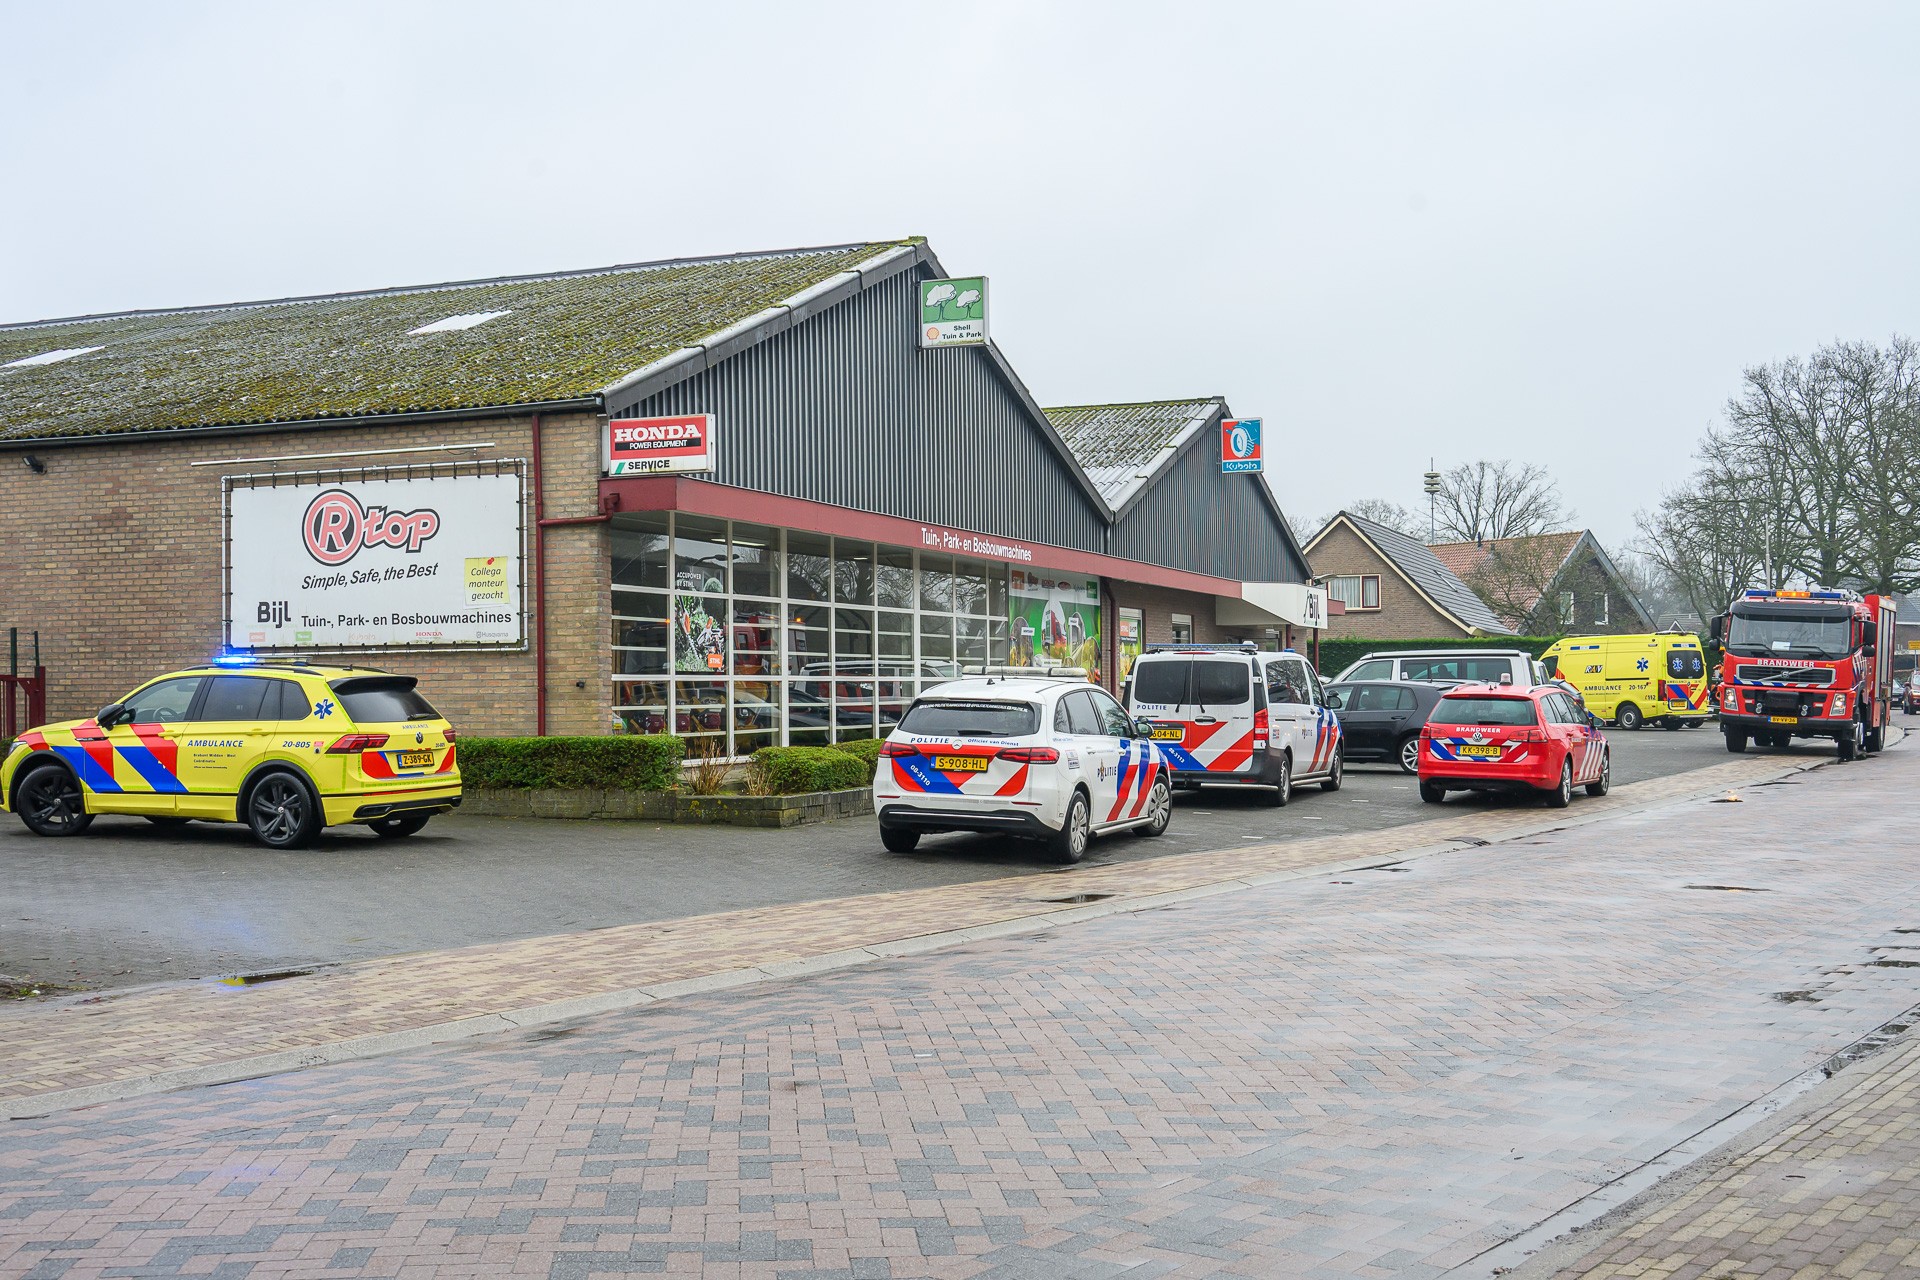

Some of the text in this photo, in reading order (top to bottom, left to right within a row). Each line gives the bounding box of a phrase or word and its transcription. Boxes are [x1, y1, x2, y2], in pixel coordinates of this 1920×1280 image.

[614, 424, 702, 442] HONDA
[629, 439, 688, 450] POWER EQUIPMENT
[628, 460, 670, 470] SERVICE
[1226, 462, 1258, 470] Kubota
[921, 527, 1032, 561] Tuin-, Park- en Bosbouwmachines
[301, 562, 439, 590] Simple, Safe, the Best
[470, 567, 502, 578] Collega
[677, 571, 701, 580] ACCUPOWER
[469, 578, 504, 588] monteur
[683, 580, 695, 588] STIHL
[471, 590, 504, 601] gezocht
[257, 601, 292, 628] Bijl
[301, 611, 512, 628] Tuin-, Park- en Bosbouwmachines
[1585, 665, 1603, 673] RAV
[1757, 659, 1815, 668] BRANDWEER
[187, 740, 243, 748] AMBULANCE
[282, 740, 311, 748] 20-805
[1462, 746, 1498, 755] KK-398-B
[403, 754, 432, 765] Z-389-GK
[938, 758, 985, 769] S-908-HL
[910, 764, 931, 786] 08-3110
